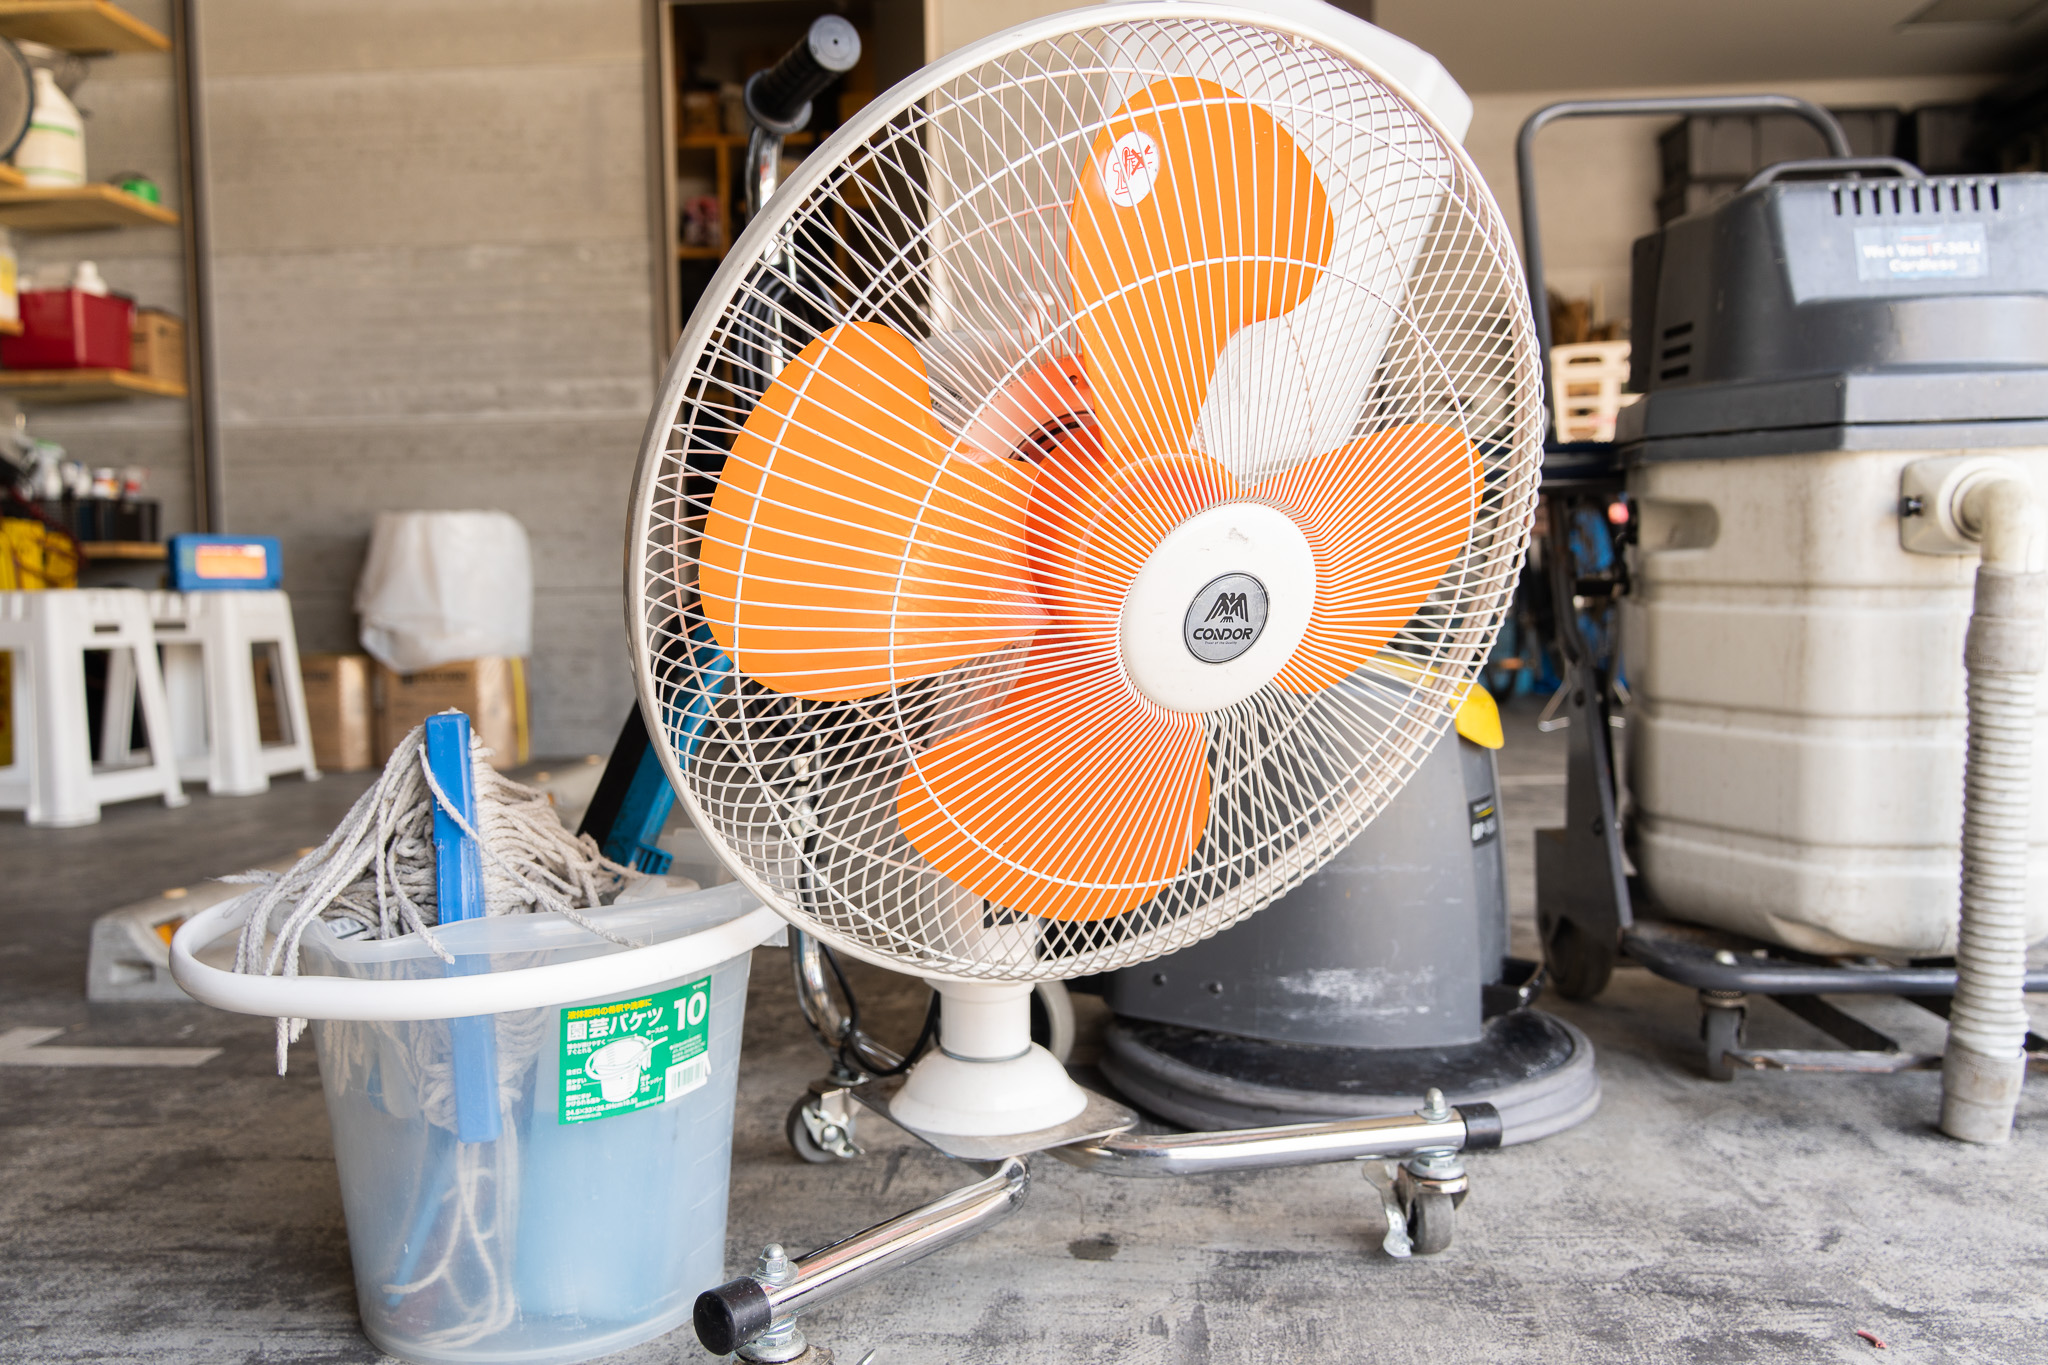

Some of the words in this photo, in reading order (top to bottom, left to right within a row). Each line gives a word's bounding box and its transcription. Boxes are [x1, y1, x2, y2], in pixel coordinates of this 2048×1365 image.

[1193, 627, 1253, 640] CONDOR
[567, 1006, 664, 1042] 園芸バケツ
[673, 991, 707, 1031] 10
